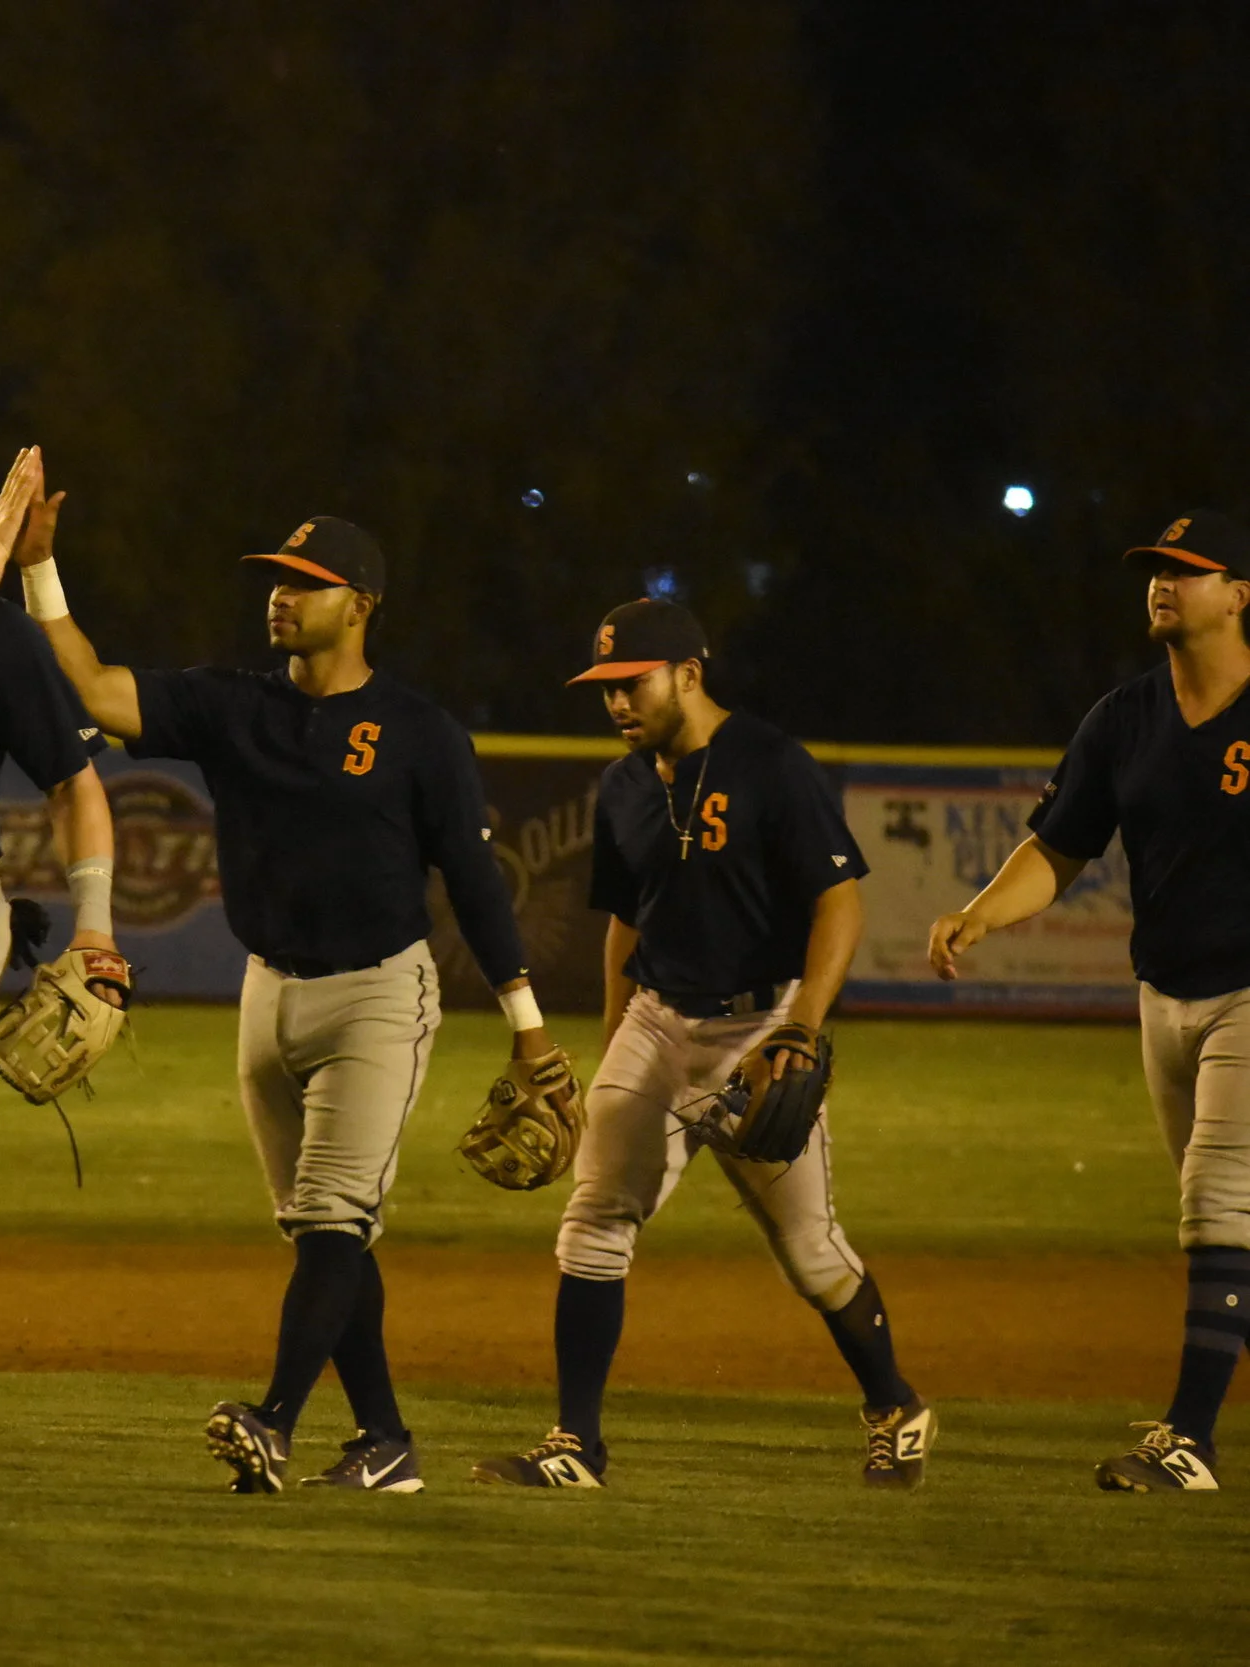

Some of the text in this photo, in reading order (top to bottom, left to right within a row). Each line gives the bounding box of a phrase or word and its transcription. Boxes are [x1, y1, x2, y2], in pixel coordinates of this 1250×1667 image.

[288, 522, 316, 547] S
[1166, 518, 1192, 541] S
[598, 624, 616, 656] S
[342, 721, 382, 776] S
[1220, 740, 1250, 795] S
[701, 792, 729, 852] S
[1164, 1452, 1199, 1484] N
